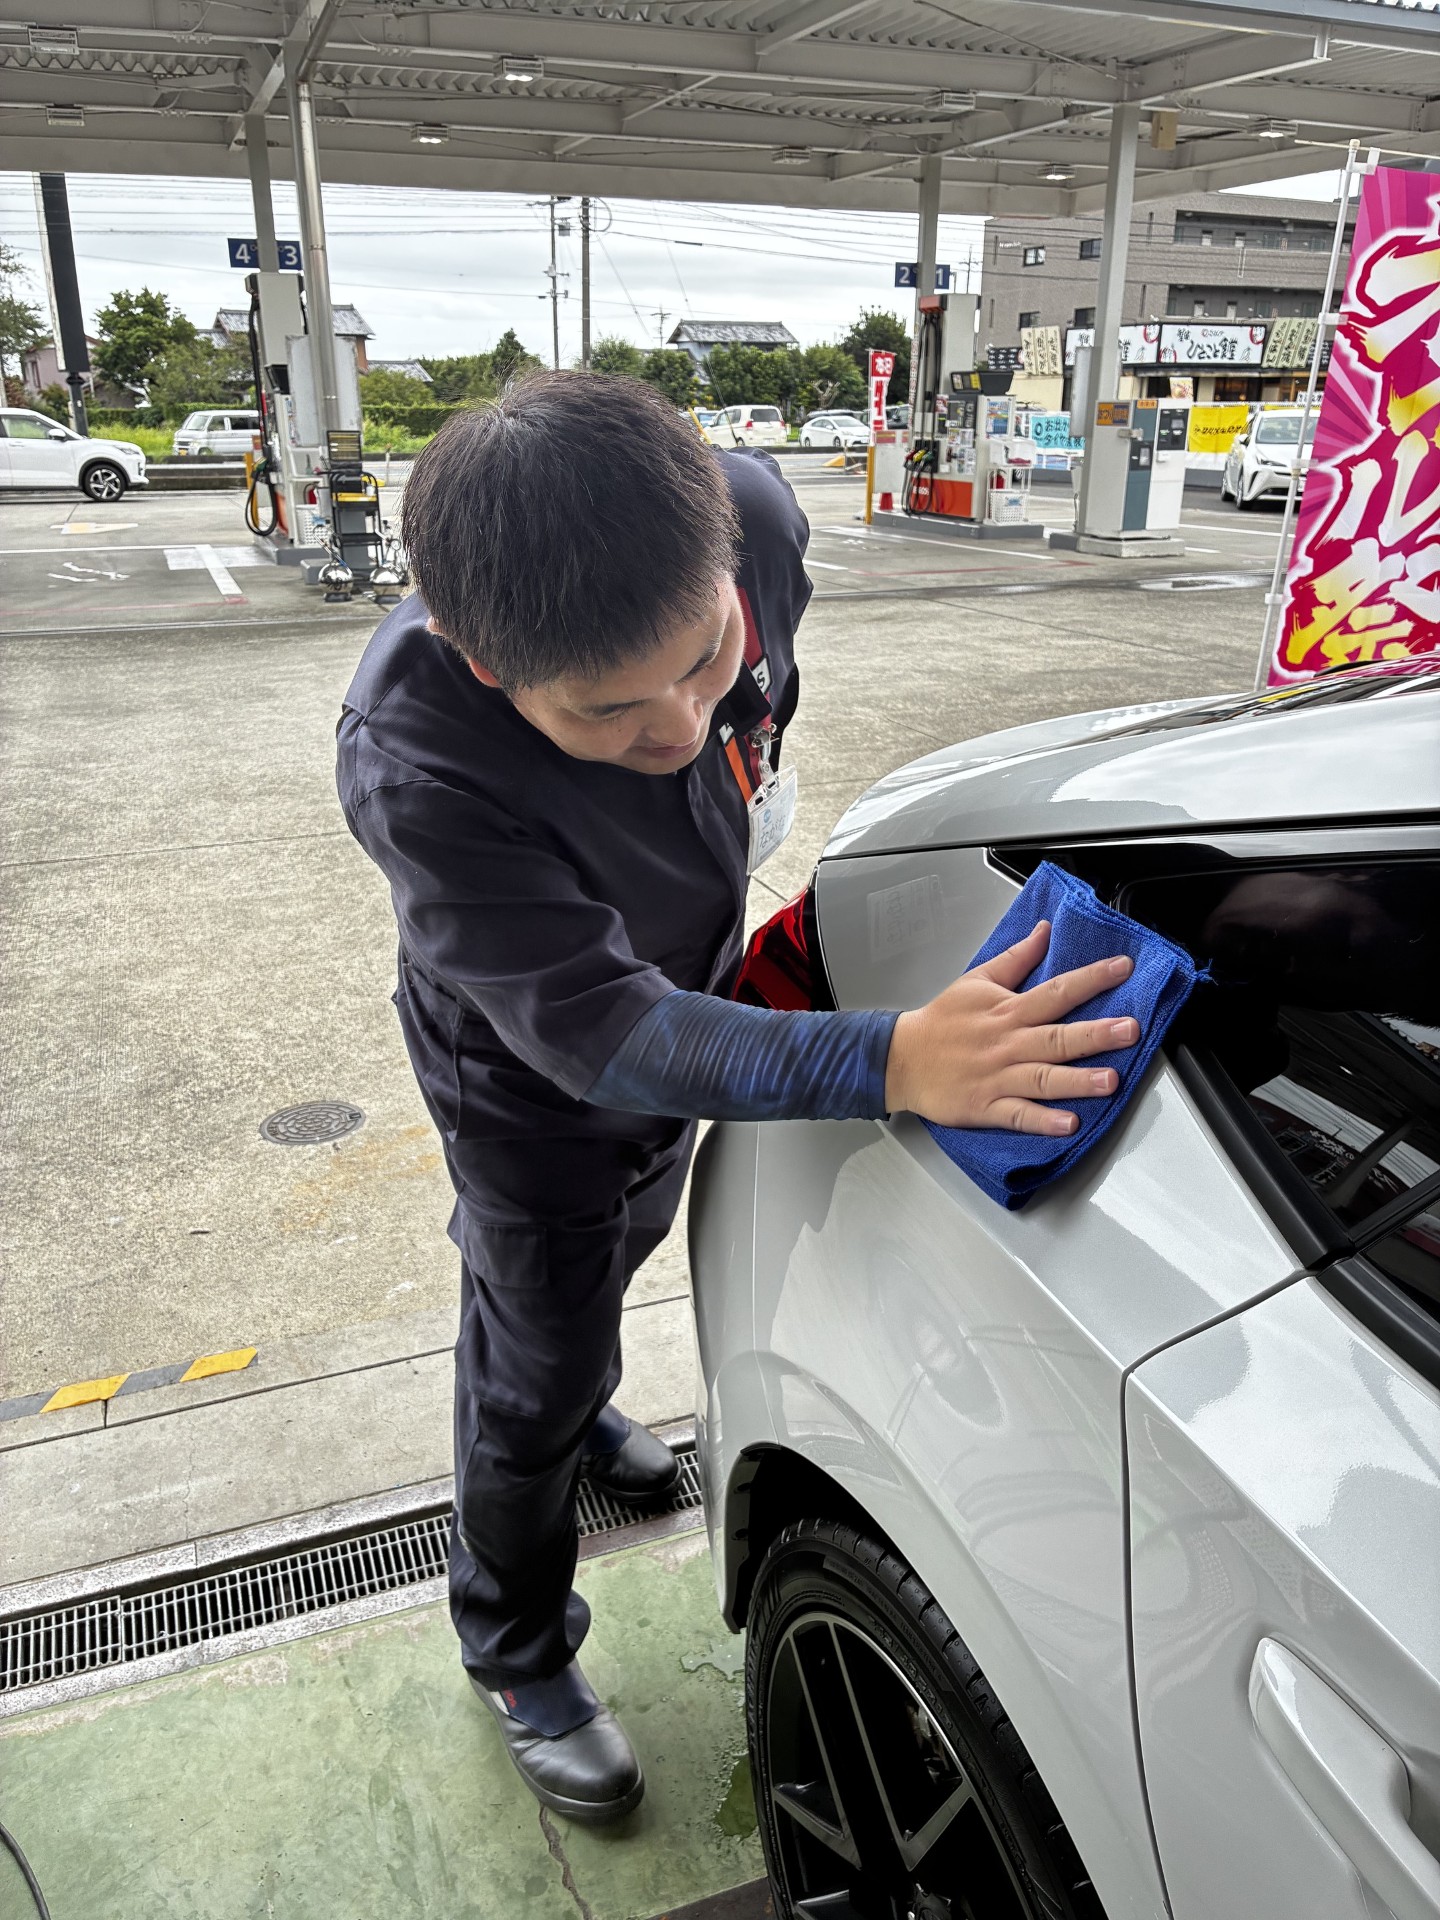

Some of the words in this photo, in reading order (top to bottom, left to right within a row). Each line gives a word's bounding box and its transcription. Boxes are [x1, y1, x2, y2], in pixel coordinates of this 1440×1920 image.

[235, 243, 251, 264] 4
[284, 245, 298, 266] 3
[899, 266, 910, 284] 2
[935, 268, 944, 286] 1
